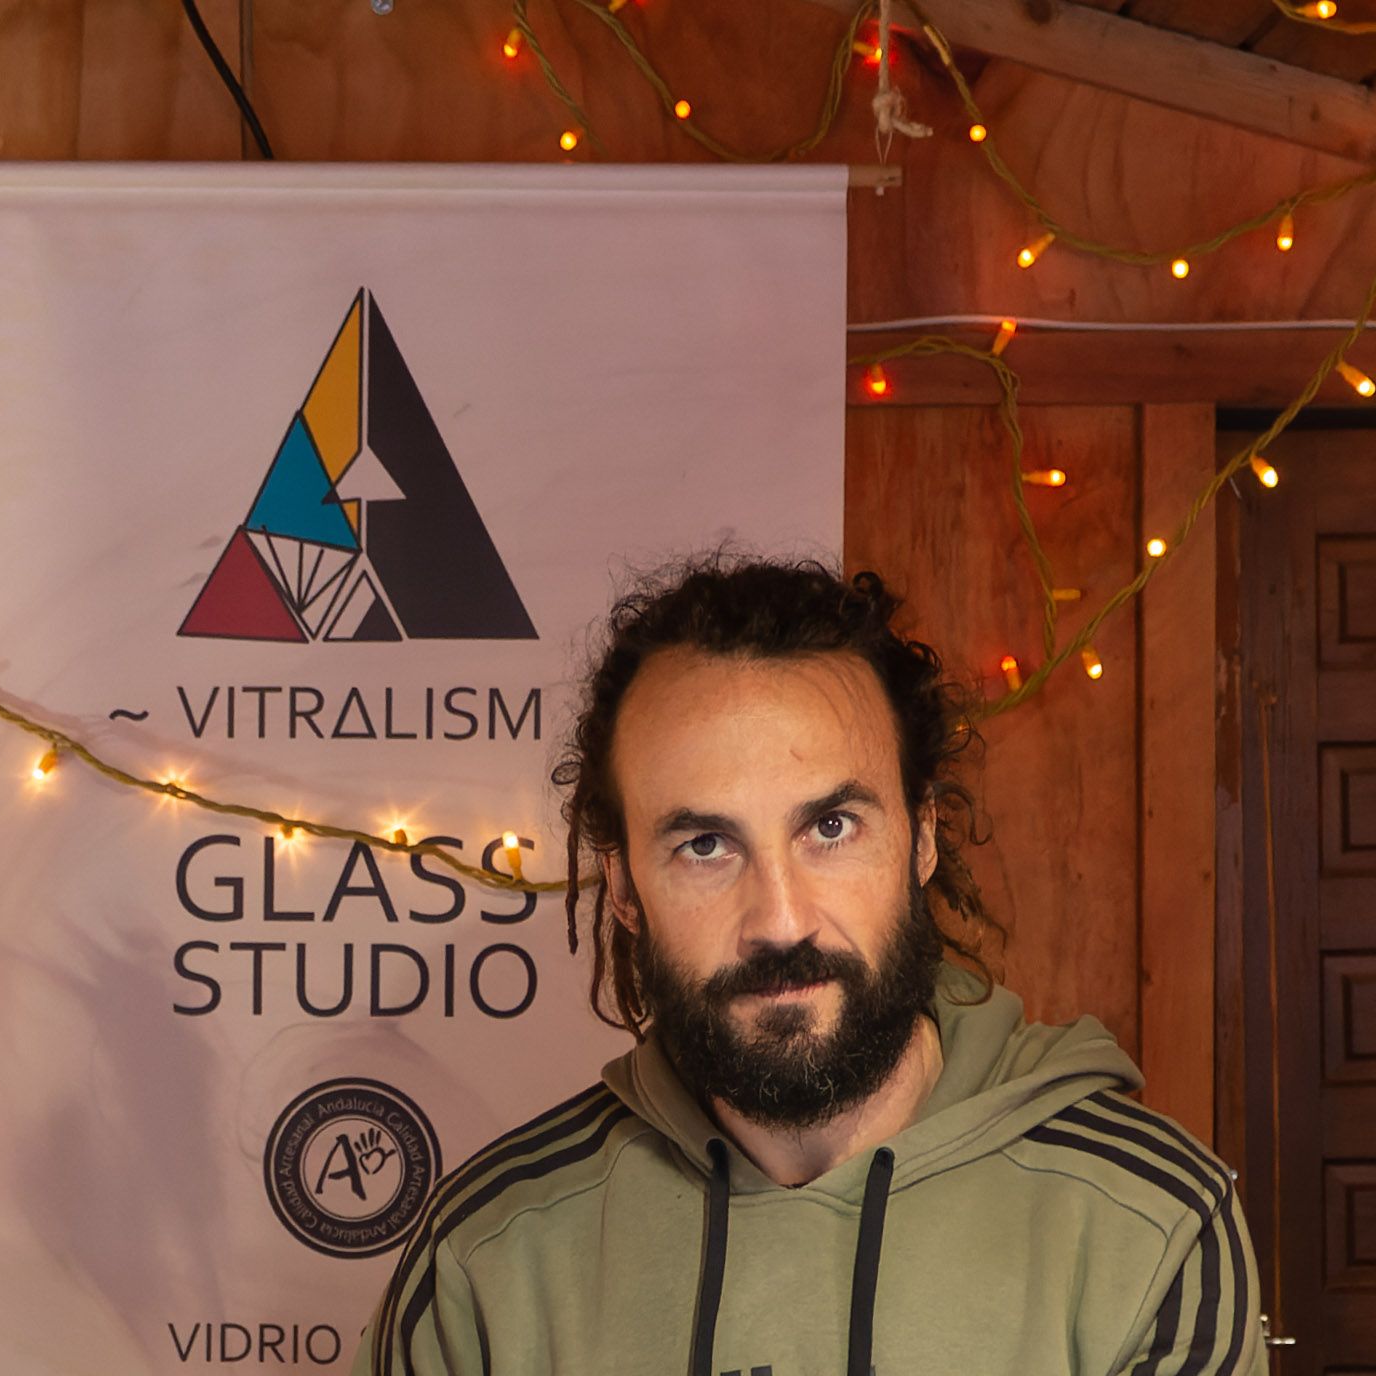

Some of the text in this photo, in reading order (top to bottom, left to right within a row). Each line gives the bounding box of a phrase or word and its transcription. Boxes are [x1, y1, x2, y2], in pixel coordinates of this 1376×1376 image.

[175, 834, 537, 924] GLASS
[172, 942, 537, 1019] STUDIO
[168, 1323, 341, 1365] VIDRIO
